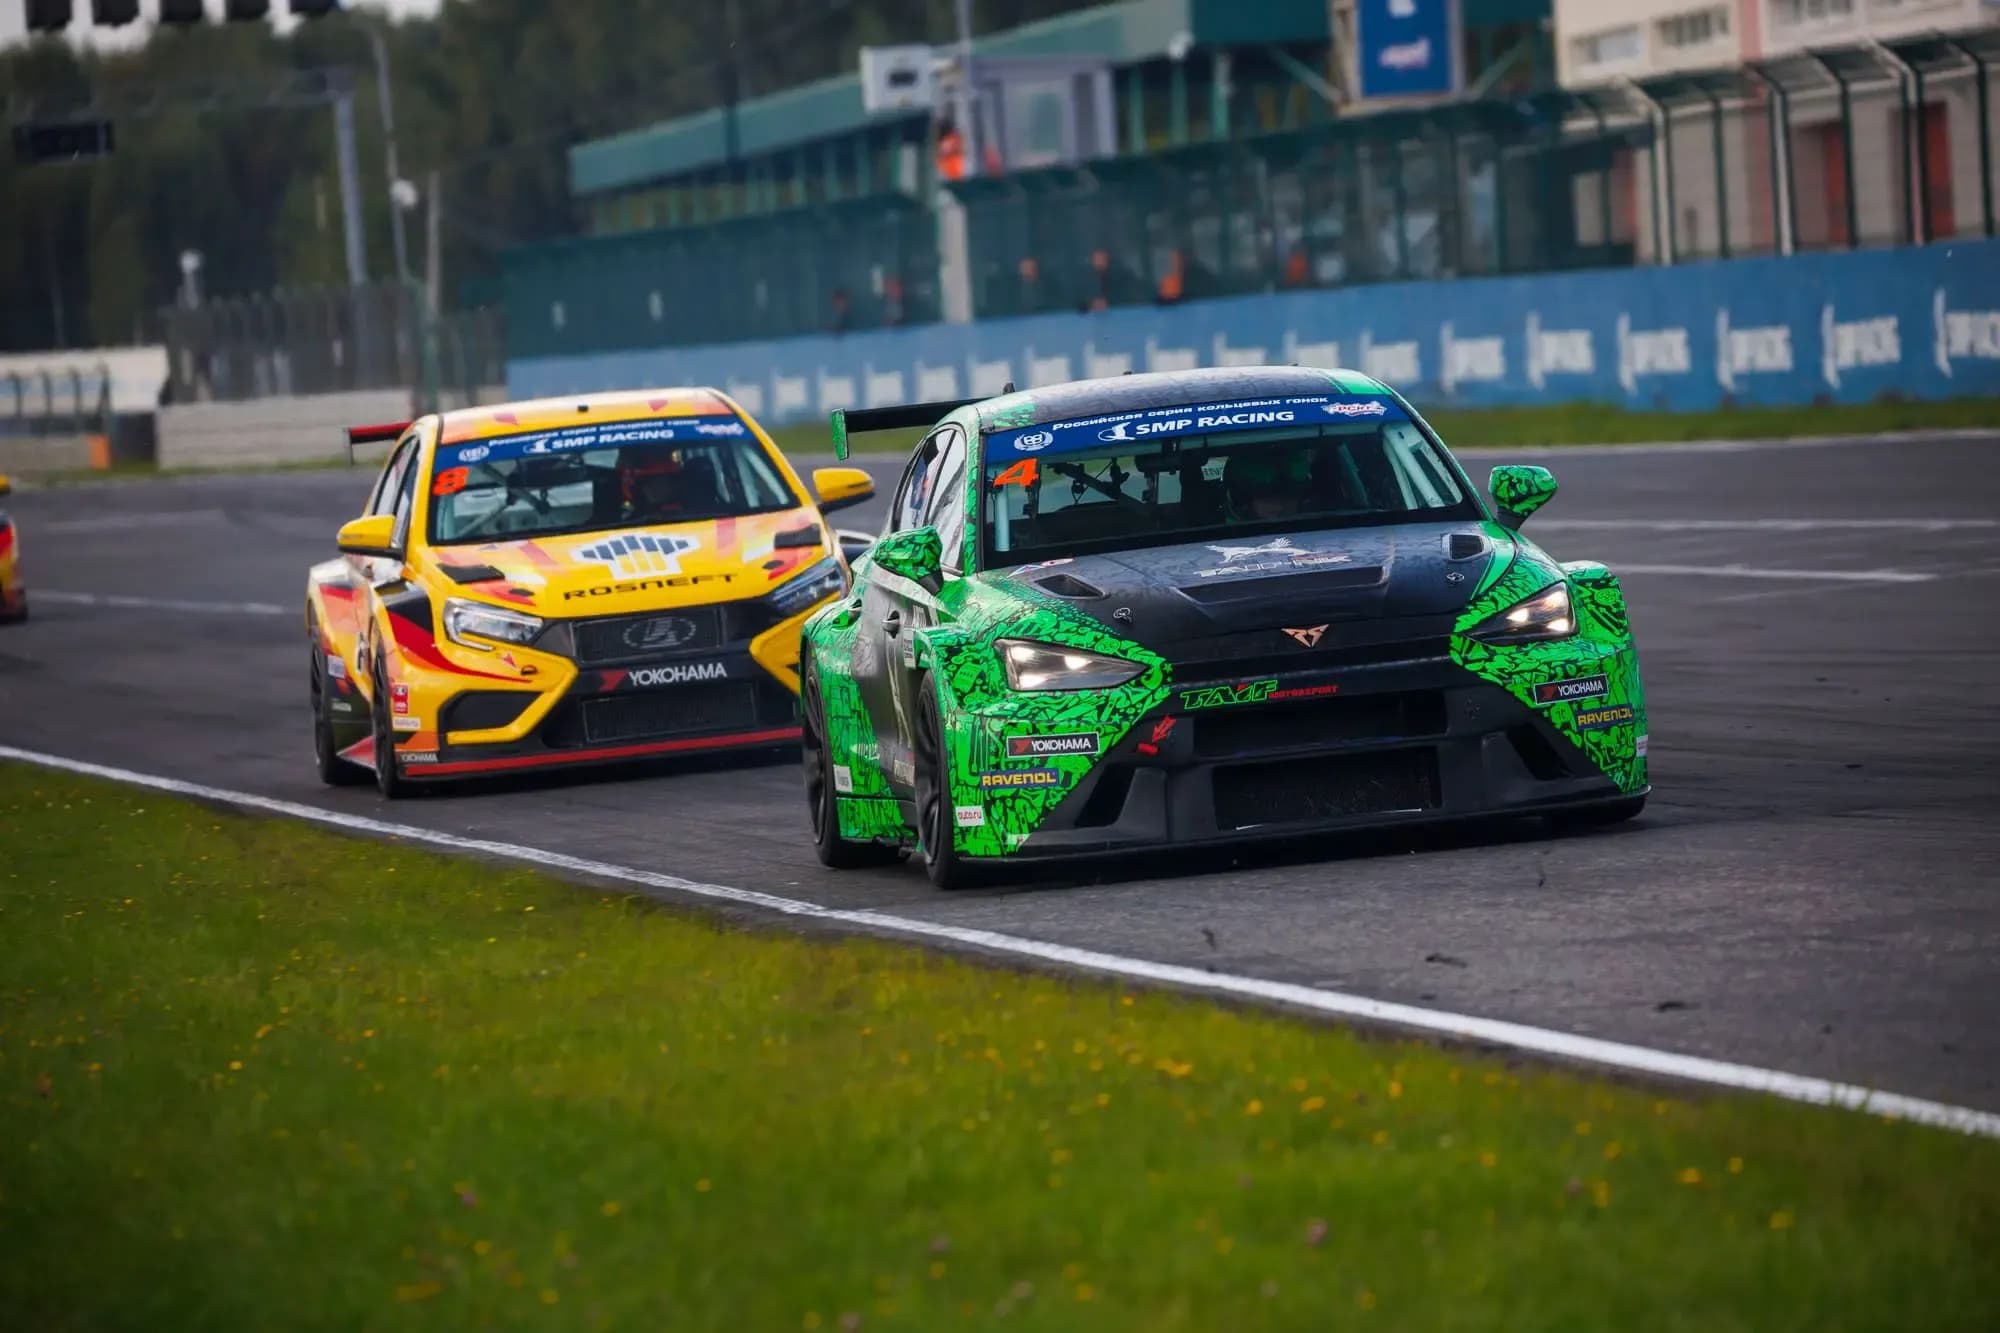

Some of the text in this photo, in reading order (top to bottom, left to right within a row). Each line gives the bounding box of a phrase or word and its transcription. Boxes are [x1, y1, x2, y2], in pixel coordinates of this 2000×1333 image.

[1053, 397, 1328, 430] Российская серия кольцевых гонок
[1136, 411, 1295, 435] SMP RACING
[552, 429, 675, 449] SMP RACING
[432, 466, 470, 496] 8
[993, 457, 1039, 487] 4
[563, 573, 738, 600] ROSNEFT
[628, 662, 728, 687] YOKOHAMA
[1558, 680, 1604, 696] YOKOHAMA
[1031, 738, 1092, 752] YOKOHAMA
[981, 771, 1057, 787] RAVENOL
